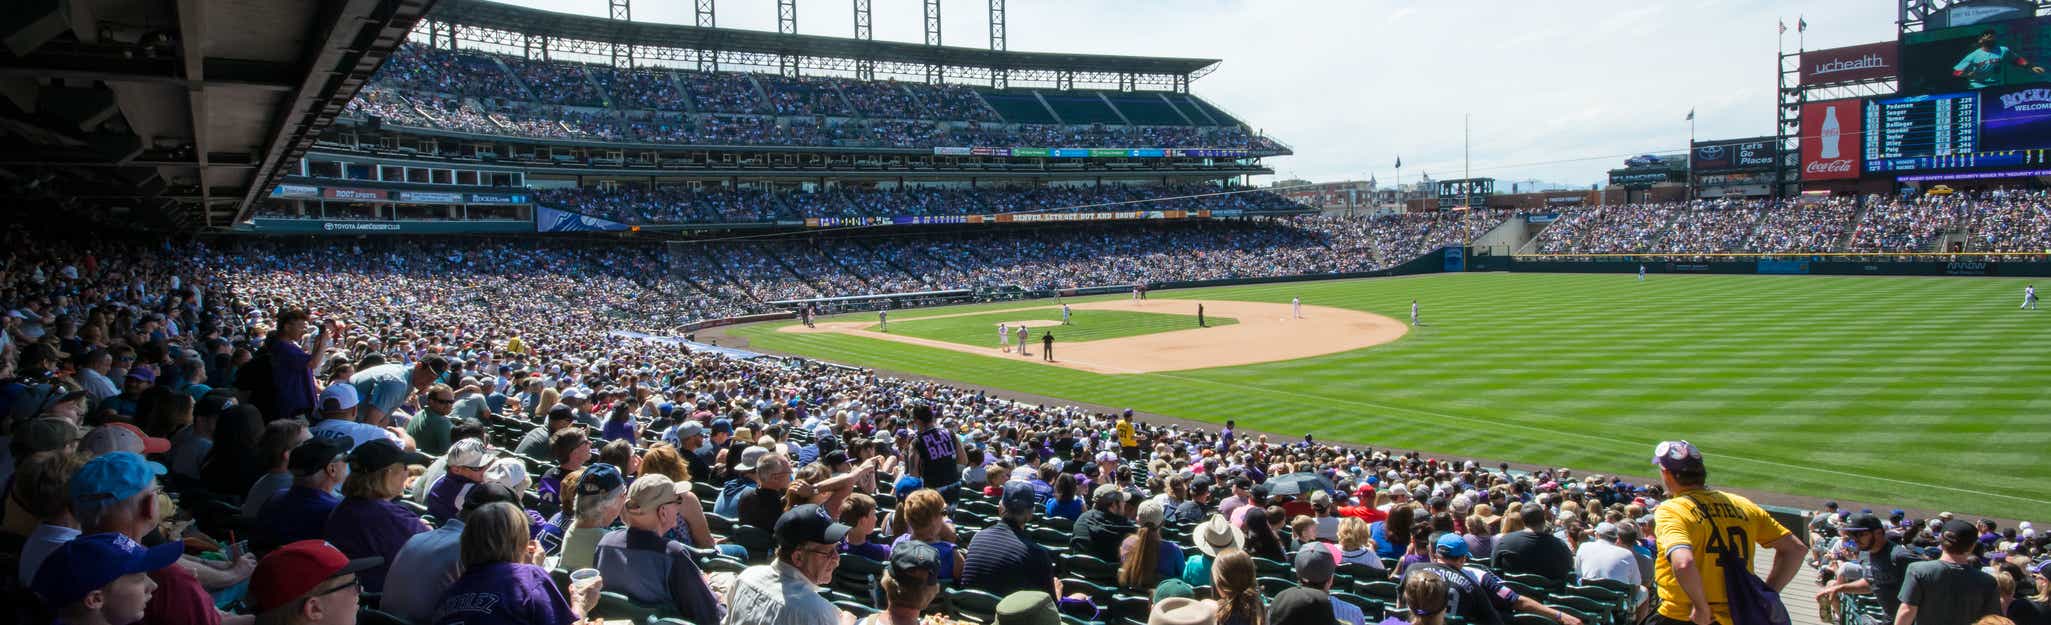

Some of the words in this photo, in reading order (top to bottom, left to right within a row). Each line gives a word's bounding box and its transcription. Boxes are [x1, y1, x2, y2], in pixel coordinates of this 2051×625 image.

[1815, 53, 1883, 74] uchealth
[2000, 88, 2051, 109] ROCKI
[1741, 142, 1763, 150] Let's
[1741, 157, 1773, 165] Places
[1705, 526, 1748, 567] 40
